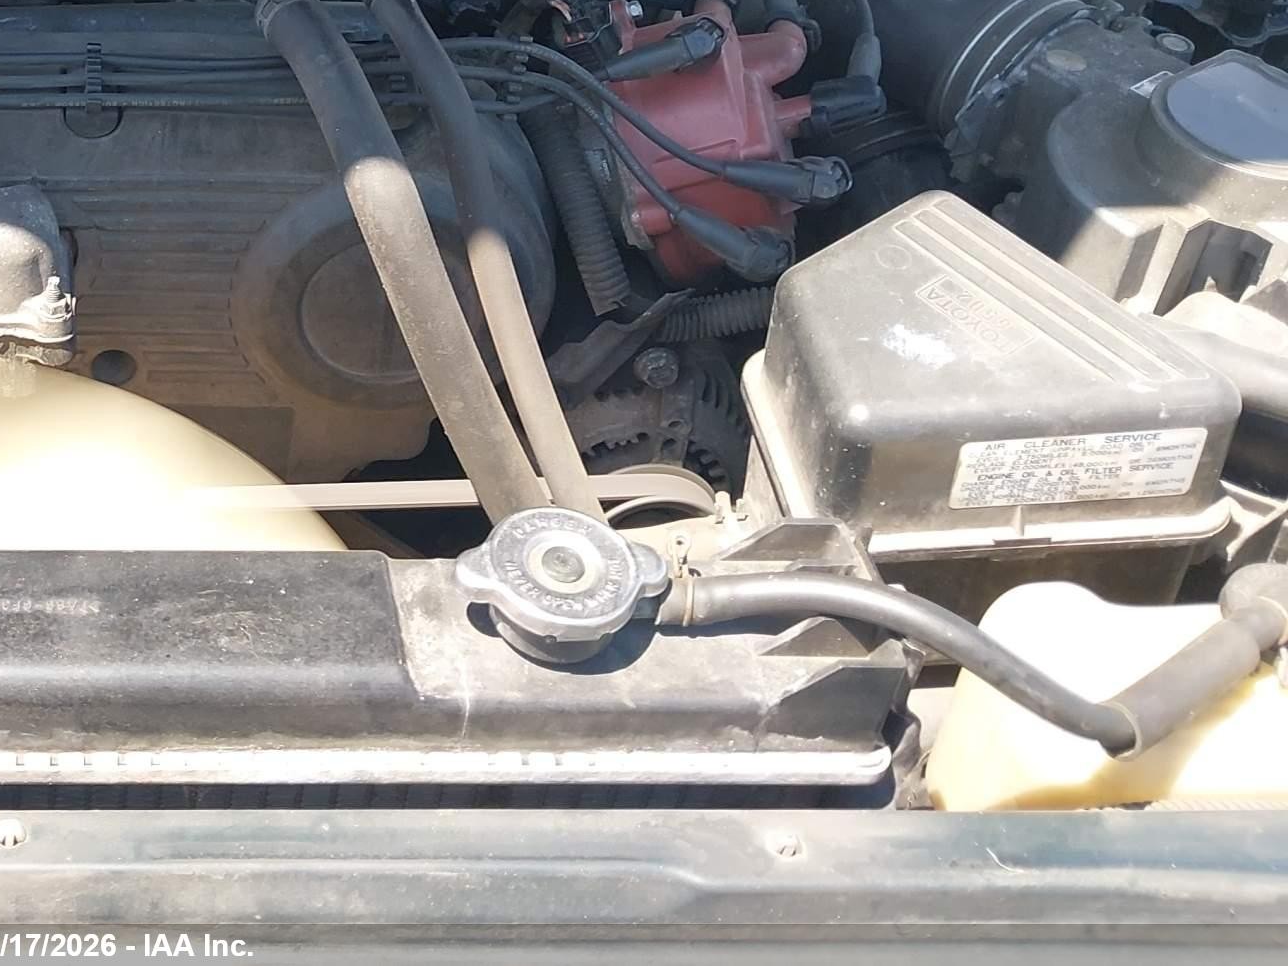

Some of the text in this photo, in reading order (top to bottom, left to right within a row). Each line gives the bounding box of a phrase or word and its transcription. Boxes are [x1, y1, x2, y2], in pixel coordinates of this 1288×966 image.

[927, 286, 1018, 353] TOYOTA
[985, 442, 1006, 451] AIR
[1023, 438, 1087, 449] CLEANER
[1104, 432, 1163, 444] SERVICE
[977, 473, 1013, 481] ENGINE
[1060, 468, 1078, 476] OIL
[1084, 465, 1123, 475] FILTER
[1129, 461, 1175, 472] SERVICE
